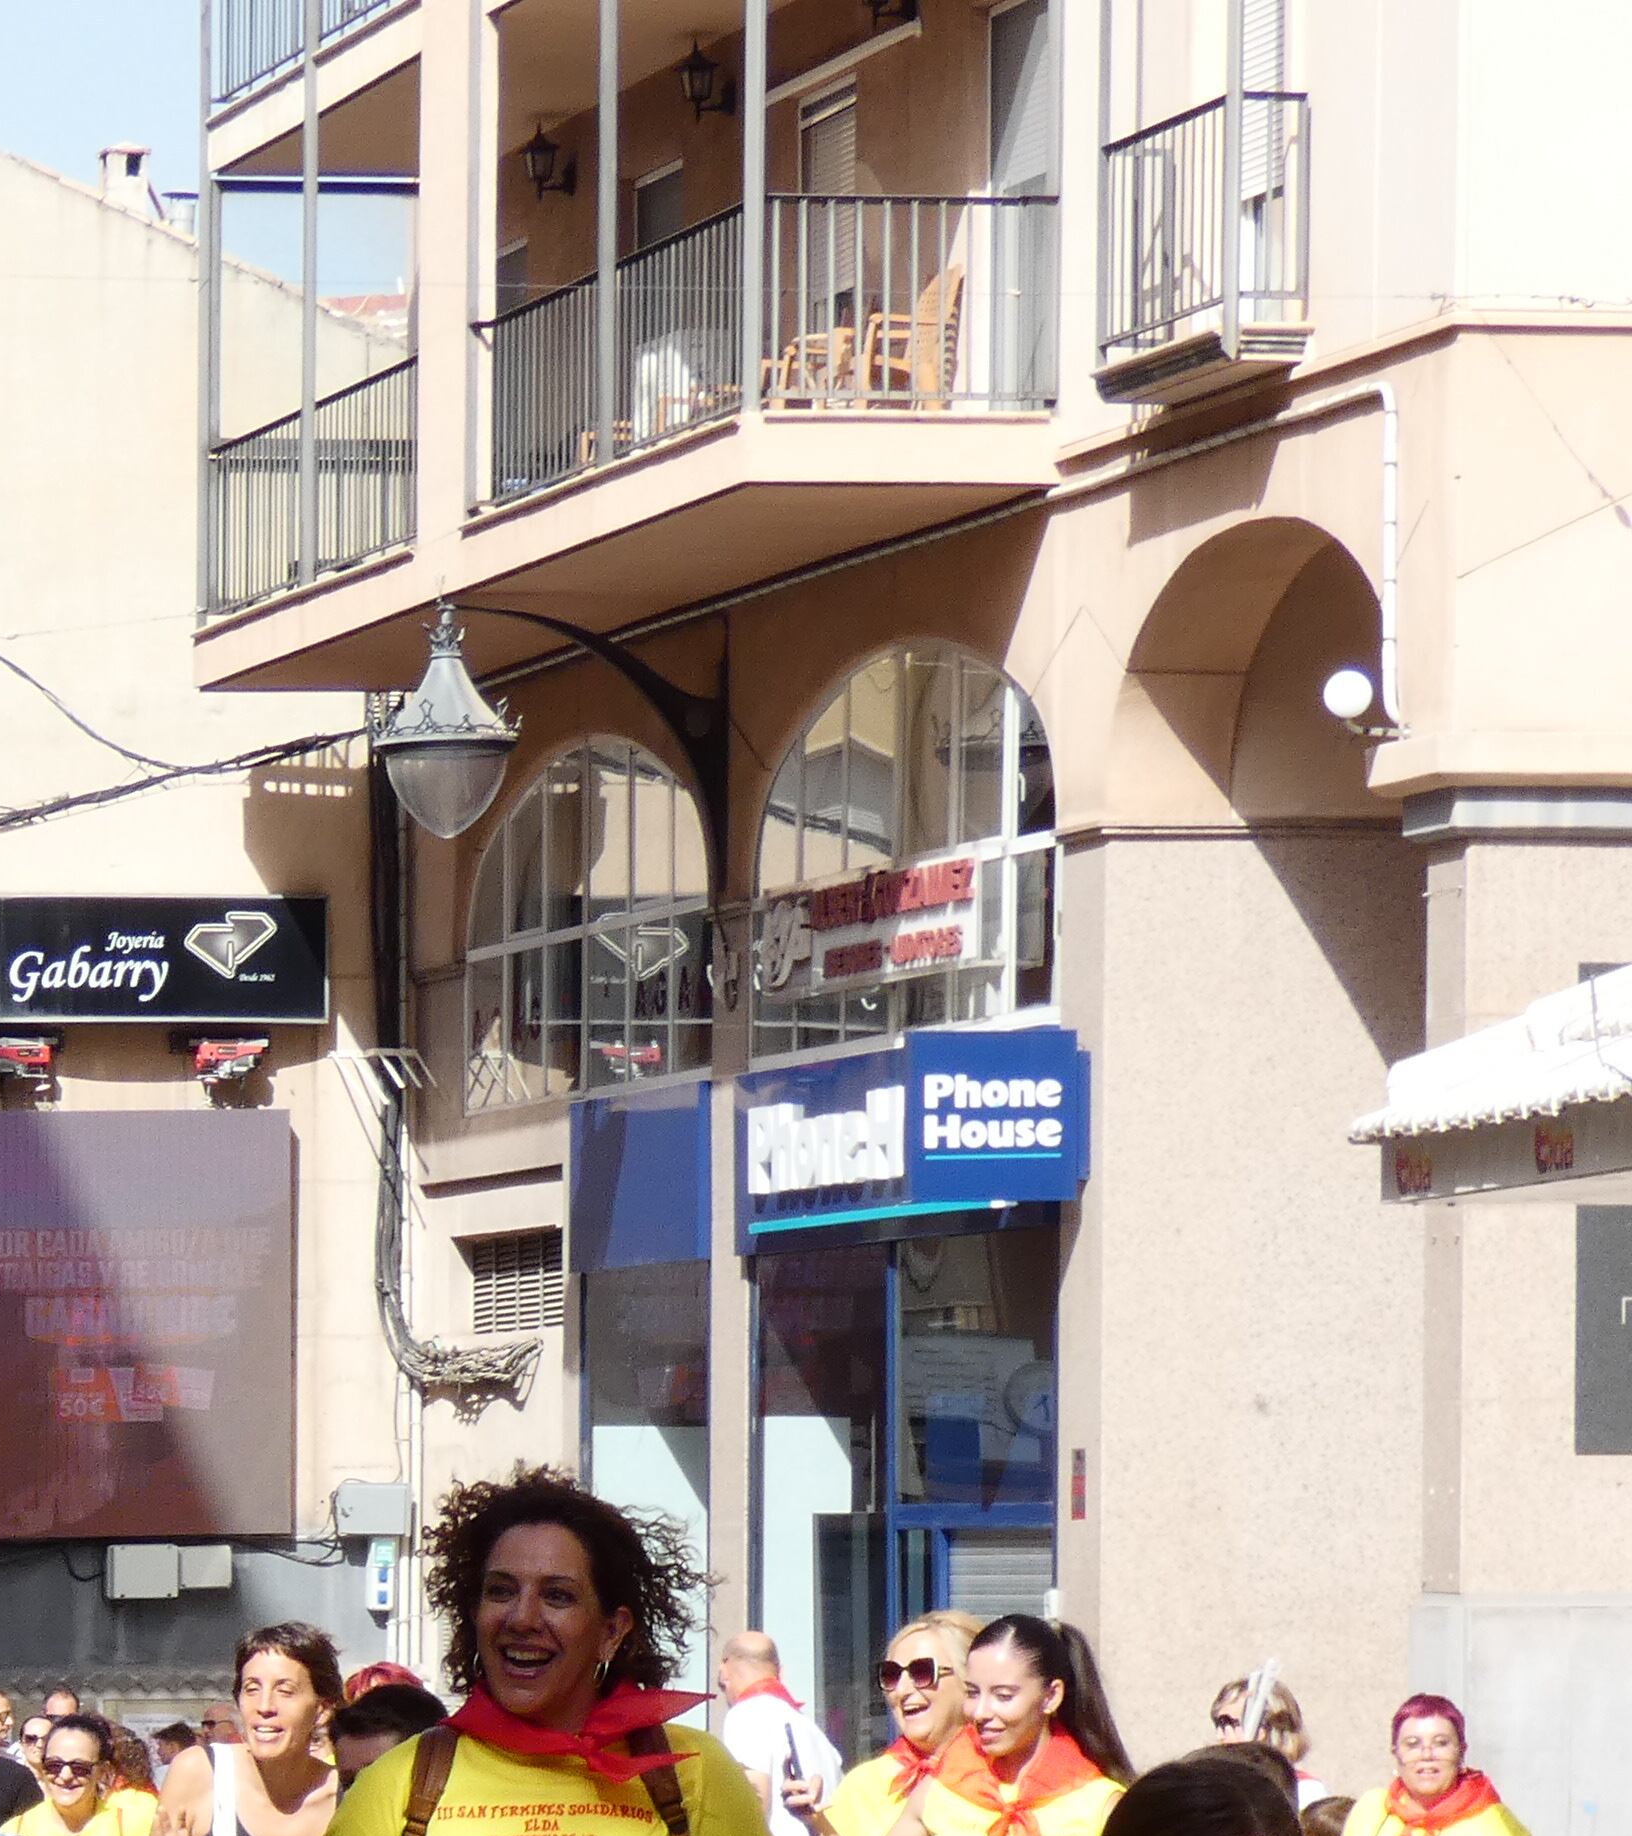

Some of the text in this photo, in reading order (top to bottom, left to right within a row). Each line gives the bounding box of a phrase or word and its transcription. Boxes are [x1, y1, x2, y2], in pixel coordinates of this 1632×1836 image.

[8, 945, 170, 1003] Gabarry
[924, 1074, 1063, 1110] Phone
[924, 1113, 1064, 1149] House
[748, 1102, 867, 1194] Phone
[36, 1229, 102, 1259] CADA
[58, 1396, 106, 1418] 50€
[456, 1805, 487, 1819] SAN
[490, 1803, 566, 1819] FERMINES
[567, 1803, 654, 1824] SOLIDARIOS
[524, 1819, 561, 1833] ELDA
